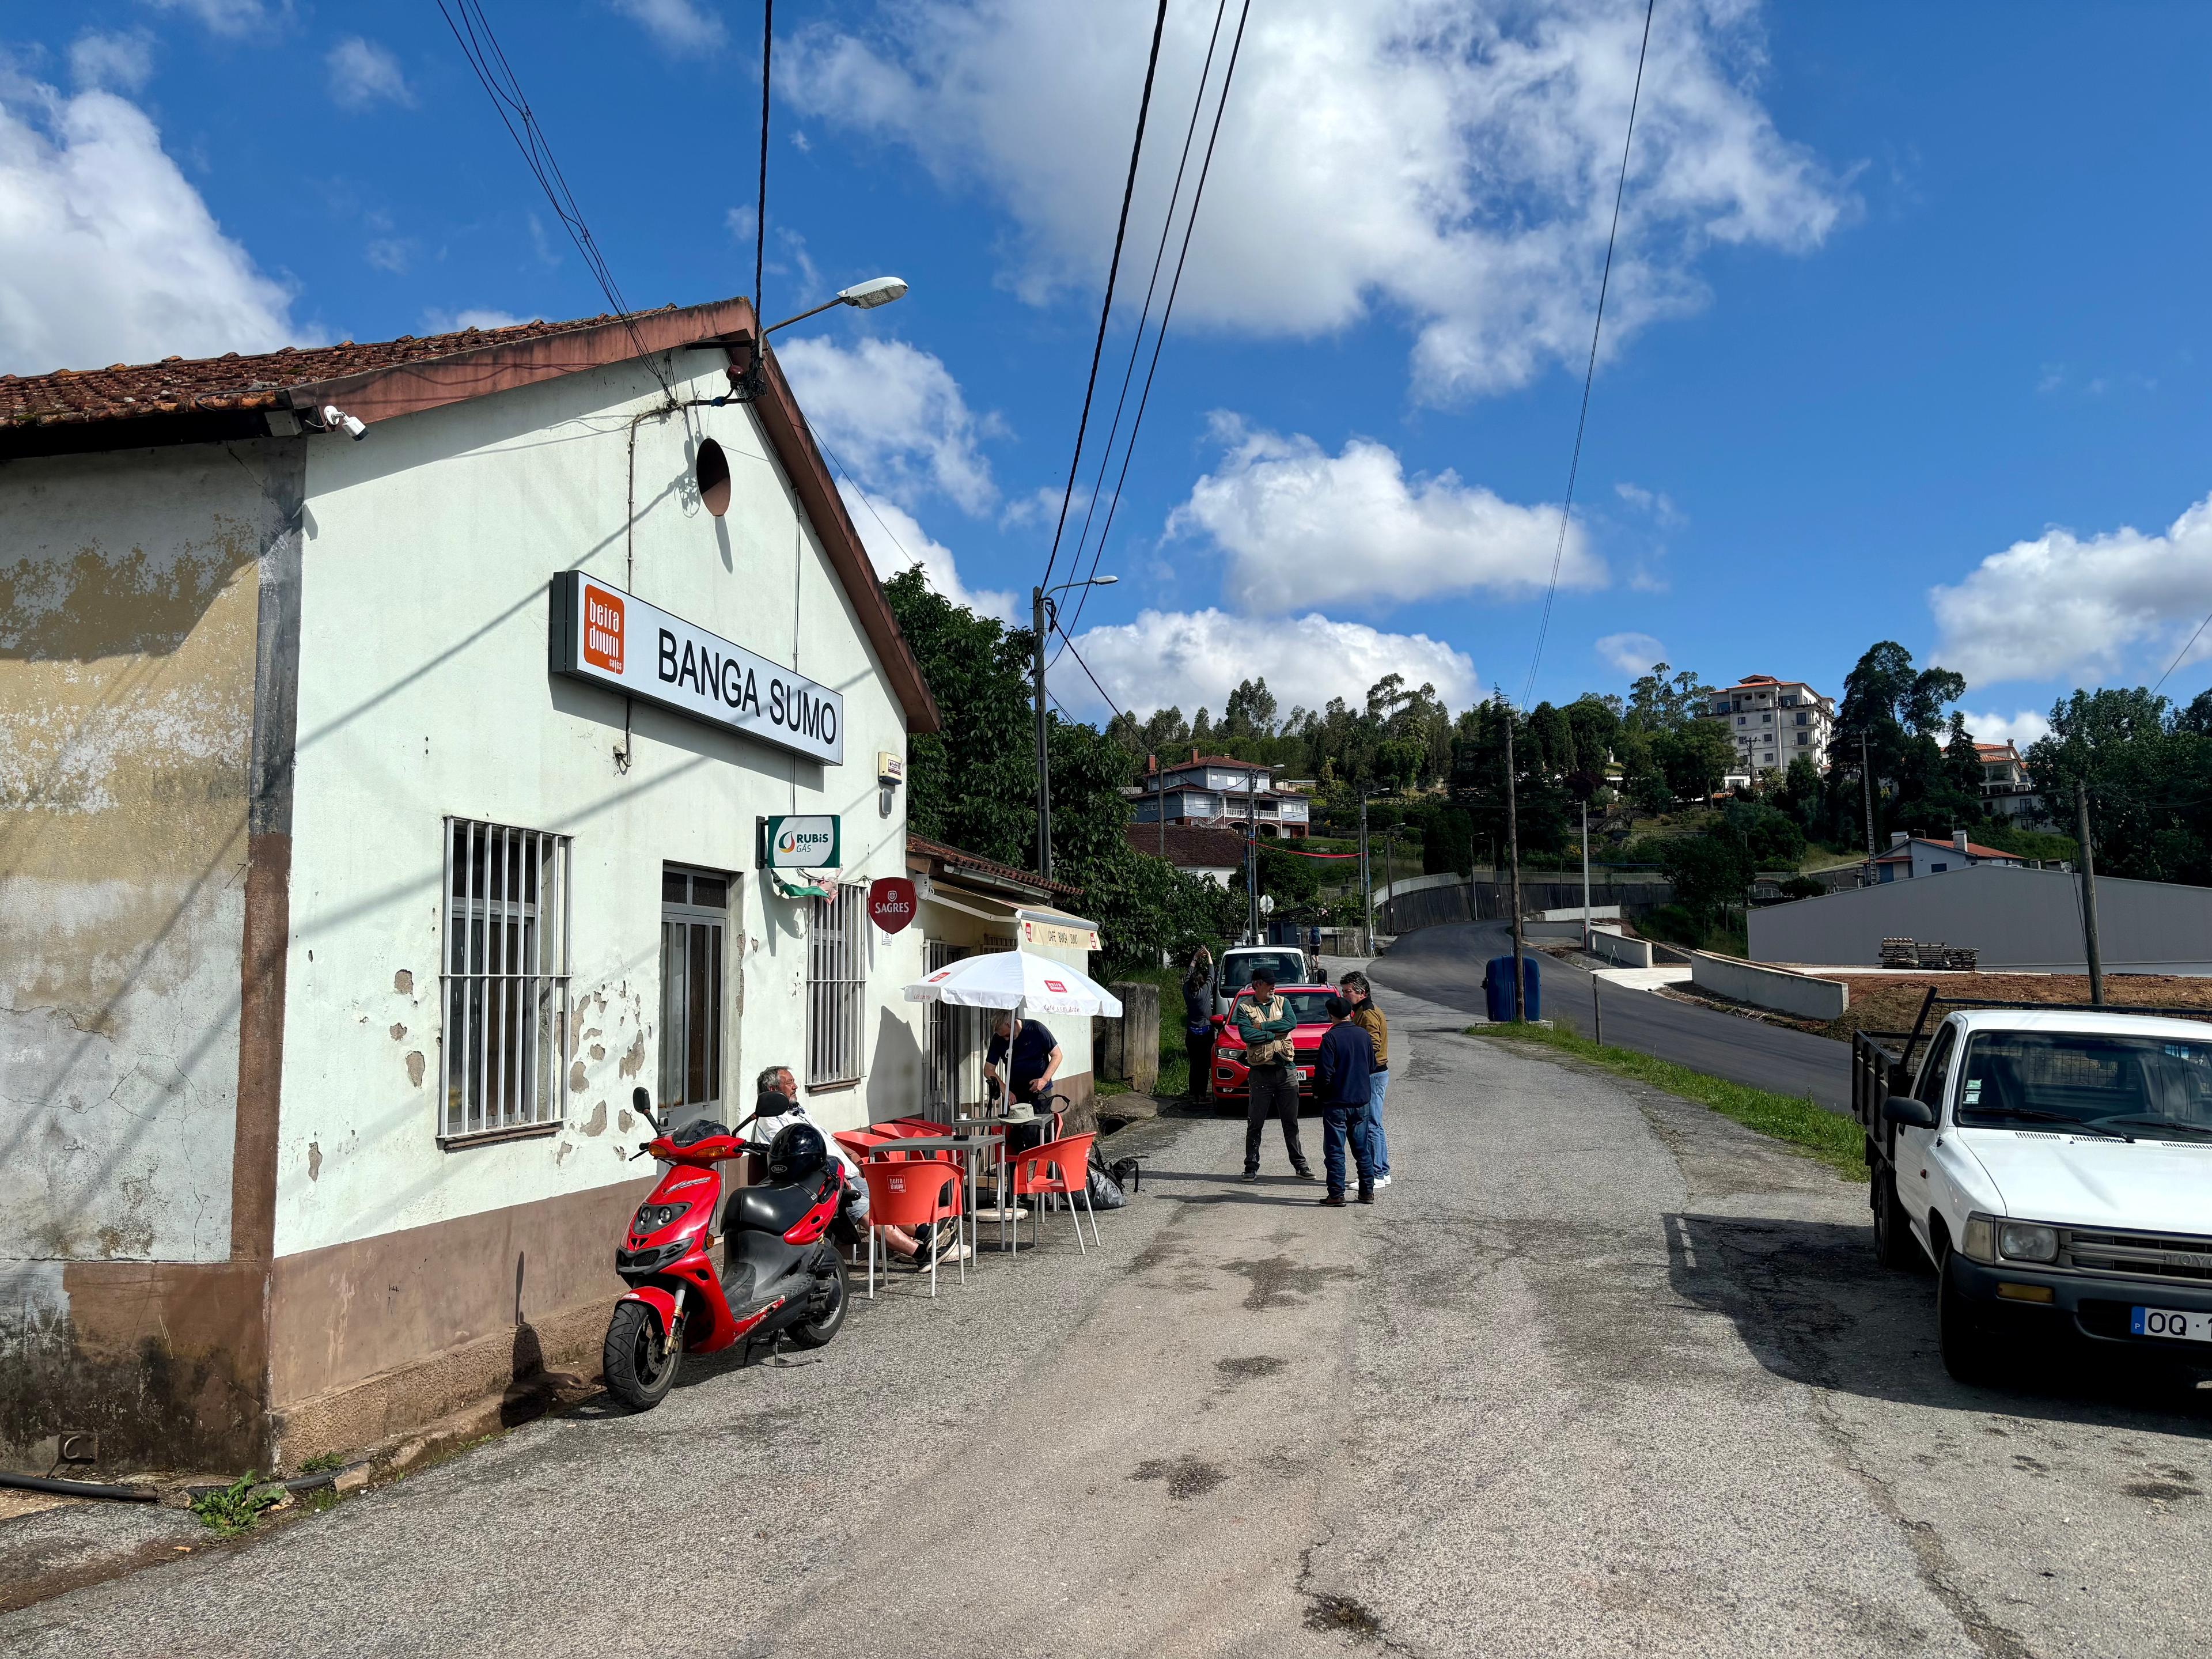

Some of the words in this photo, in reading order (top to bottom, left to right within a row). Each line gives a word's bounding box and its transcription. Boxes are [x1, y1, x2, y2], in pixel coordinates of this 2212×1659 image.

[589, 597, 619, 632] beira
[658, 627, 761, 718] BANGA
[769, 679, 836, 745] SUMO
[796, 843, 811, 853] GÁS
[875, 902, 910, 914] SAGRES
[2168, 1252, 2212, 1267] TOY
